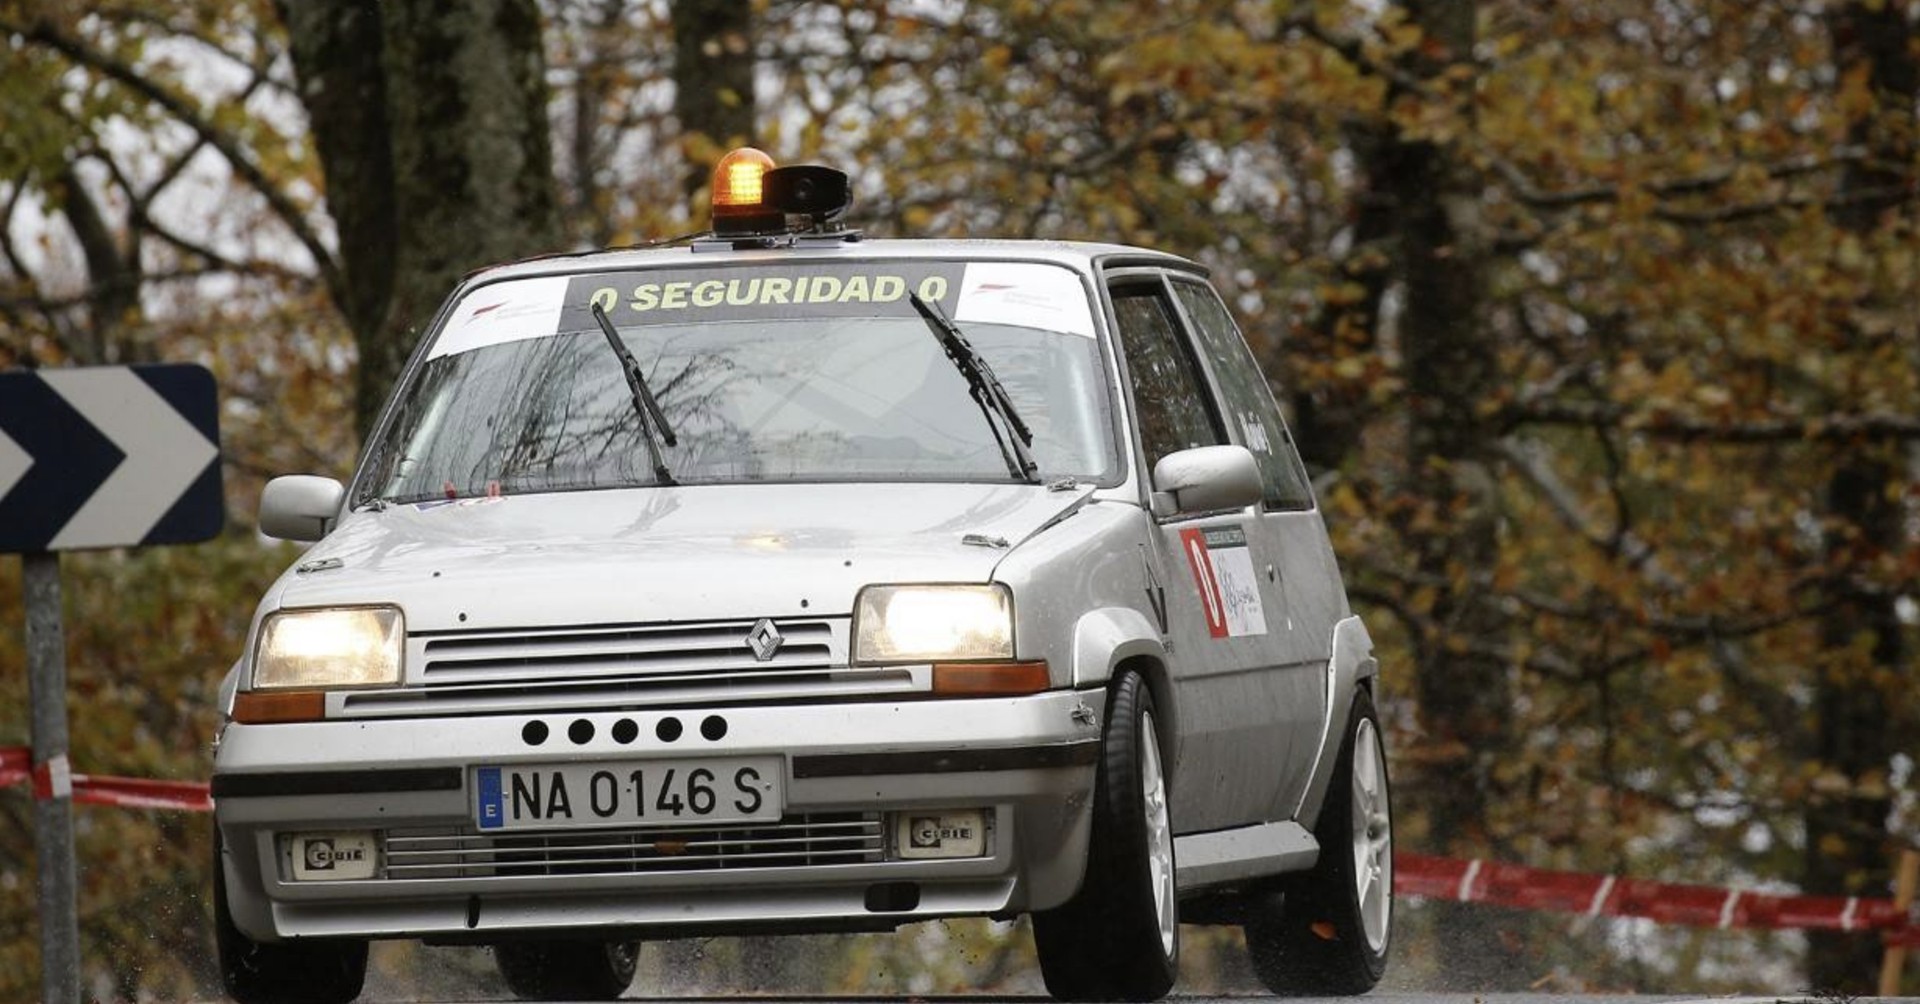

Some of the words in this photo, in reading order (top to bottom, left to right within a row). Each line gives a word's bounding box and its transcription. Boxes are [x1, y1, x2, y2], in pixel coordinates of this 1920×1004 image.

[630, 275, 905, 312] SEGURIDAD
[1190, 538, 1220, 628] 0
[485, 804, 497, 818] E
[511, 771, 573, 820] NA
[589, 767, 717, 818] 0146
[733, 766, 763, 814] S
